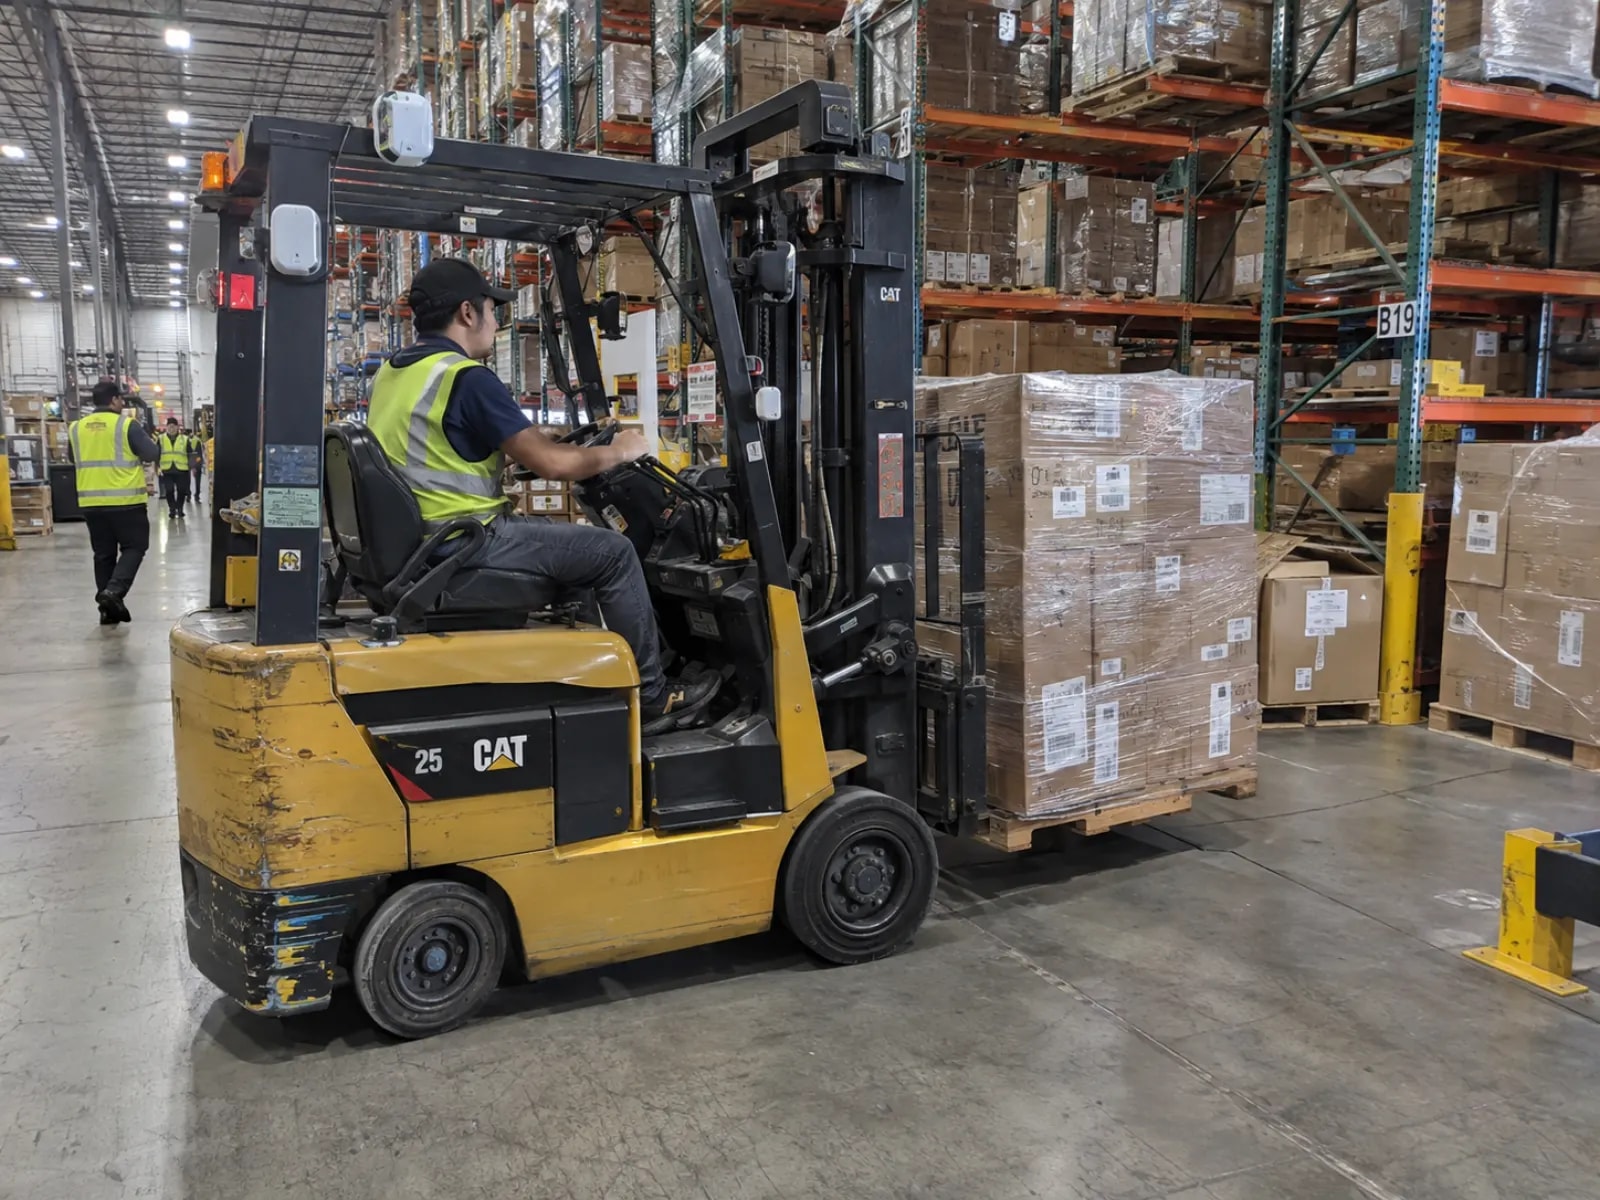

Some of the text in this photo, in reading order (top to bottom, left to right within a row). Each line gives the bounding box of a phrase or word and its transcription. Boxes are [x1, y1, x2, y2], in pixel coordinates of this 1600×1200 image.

[880, 286, 901, 302] CAT
[1379, 303, 1414, 336] B19
[414, 747, 443, 774] 25
[473, 735, 527, 772] CAT
